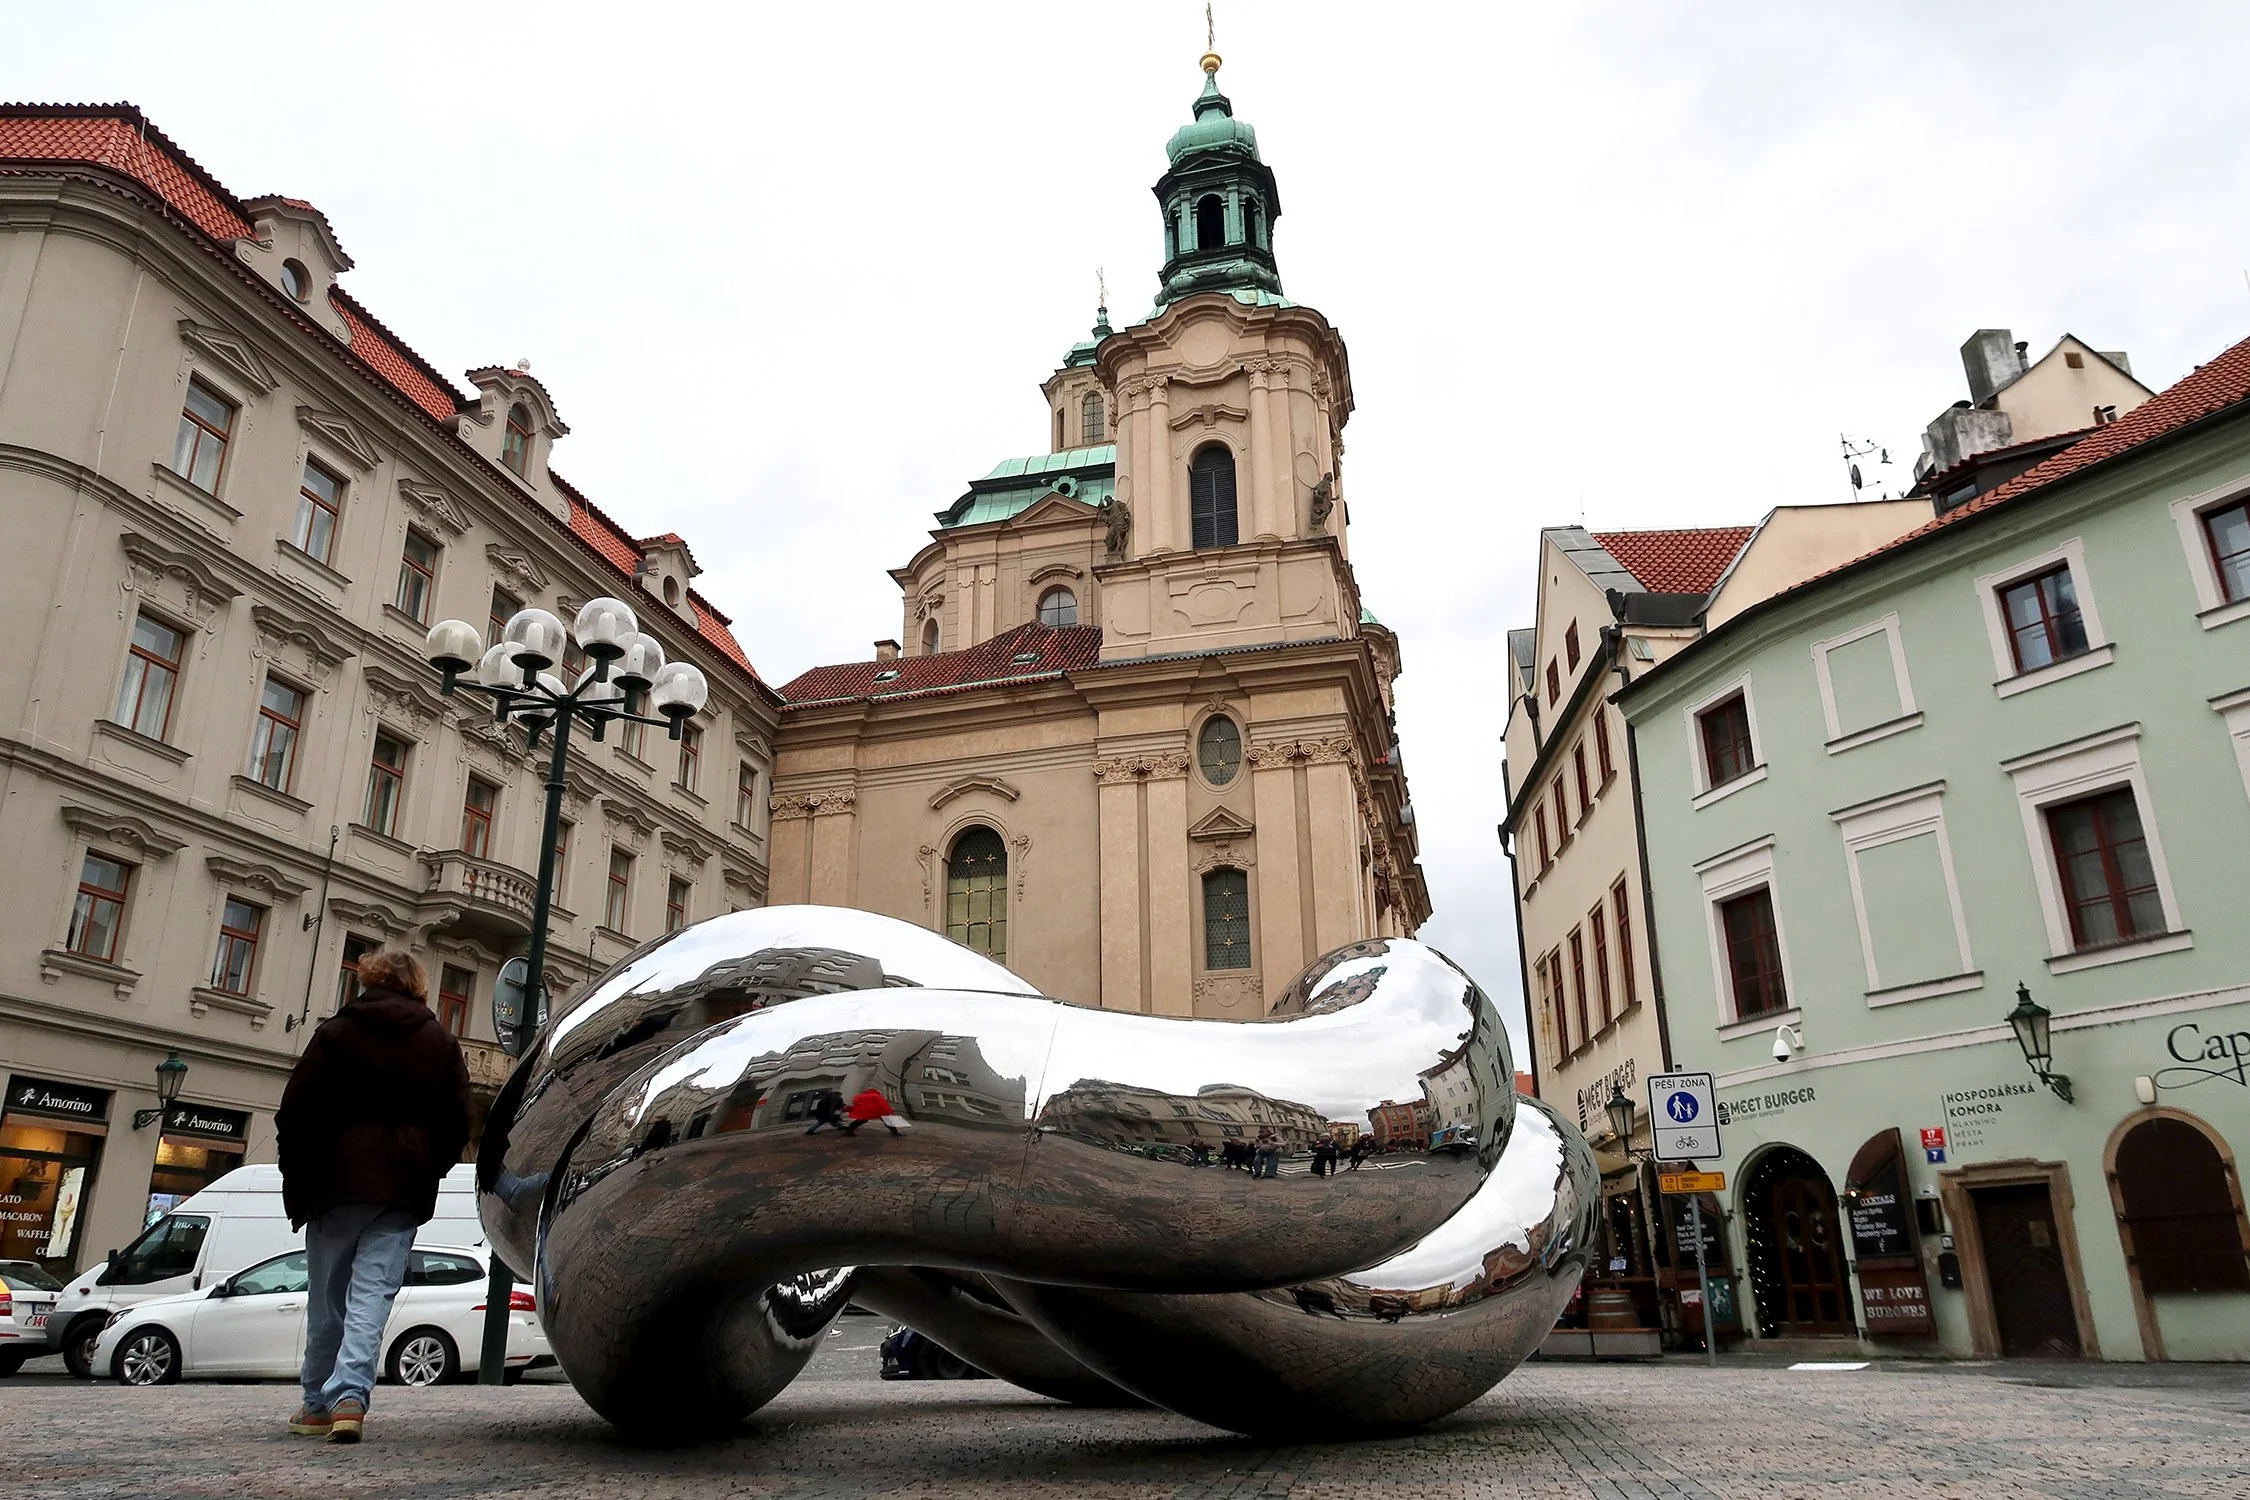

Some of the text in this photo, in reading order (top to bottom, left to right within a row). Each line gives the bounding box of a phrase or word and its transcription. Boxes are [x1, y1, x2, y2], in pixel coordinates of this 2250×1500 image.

[1655, 1077, 1706, 1090] PĚŠÍ ZÓNA
[1584, 1078, 1604, 1113] MEET
[1946, 1081, 2036, 1103] HOSPODÁŘSKÁ
[38, 1092, 92, 1113] Amorino
[1730, 1087, 1816, 1115] MEET BURGER
[1949, 1103, 2003, 1117] KOMORA
[188, 1115, 233, 1133] Amorino
[1931, 1151, 1937, 1160] 7
[1863, 1286, 1923, 1300] WE LOVE
[1866, 1304, 1927, 1318] BURGERS
